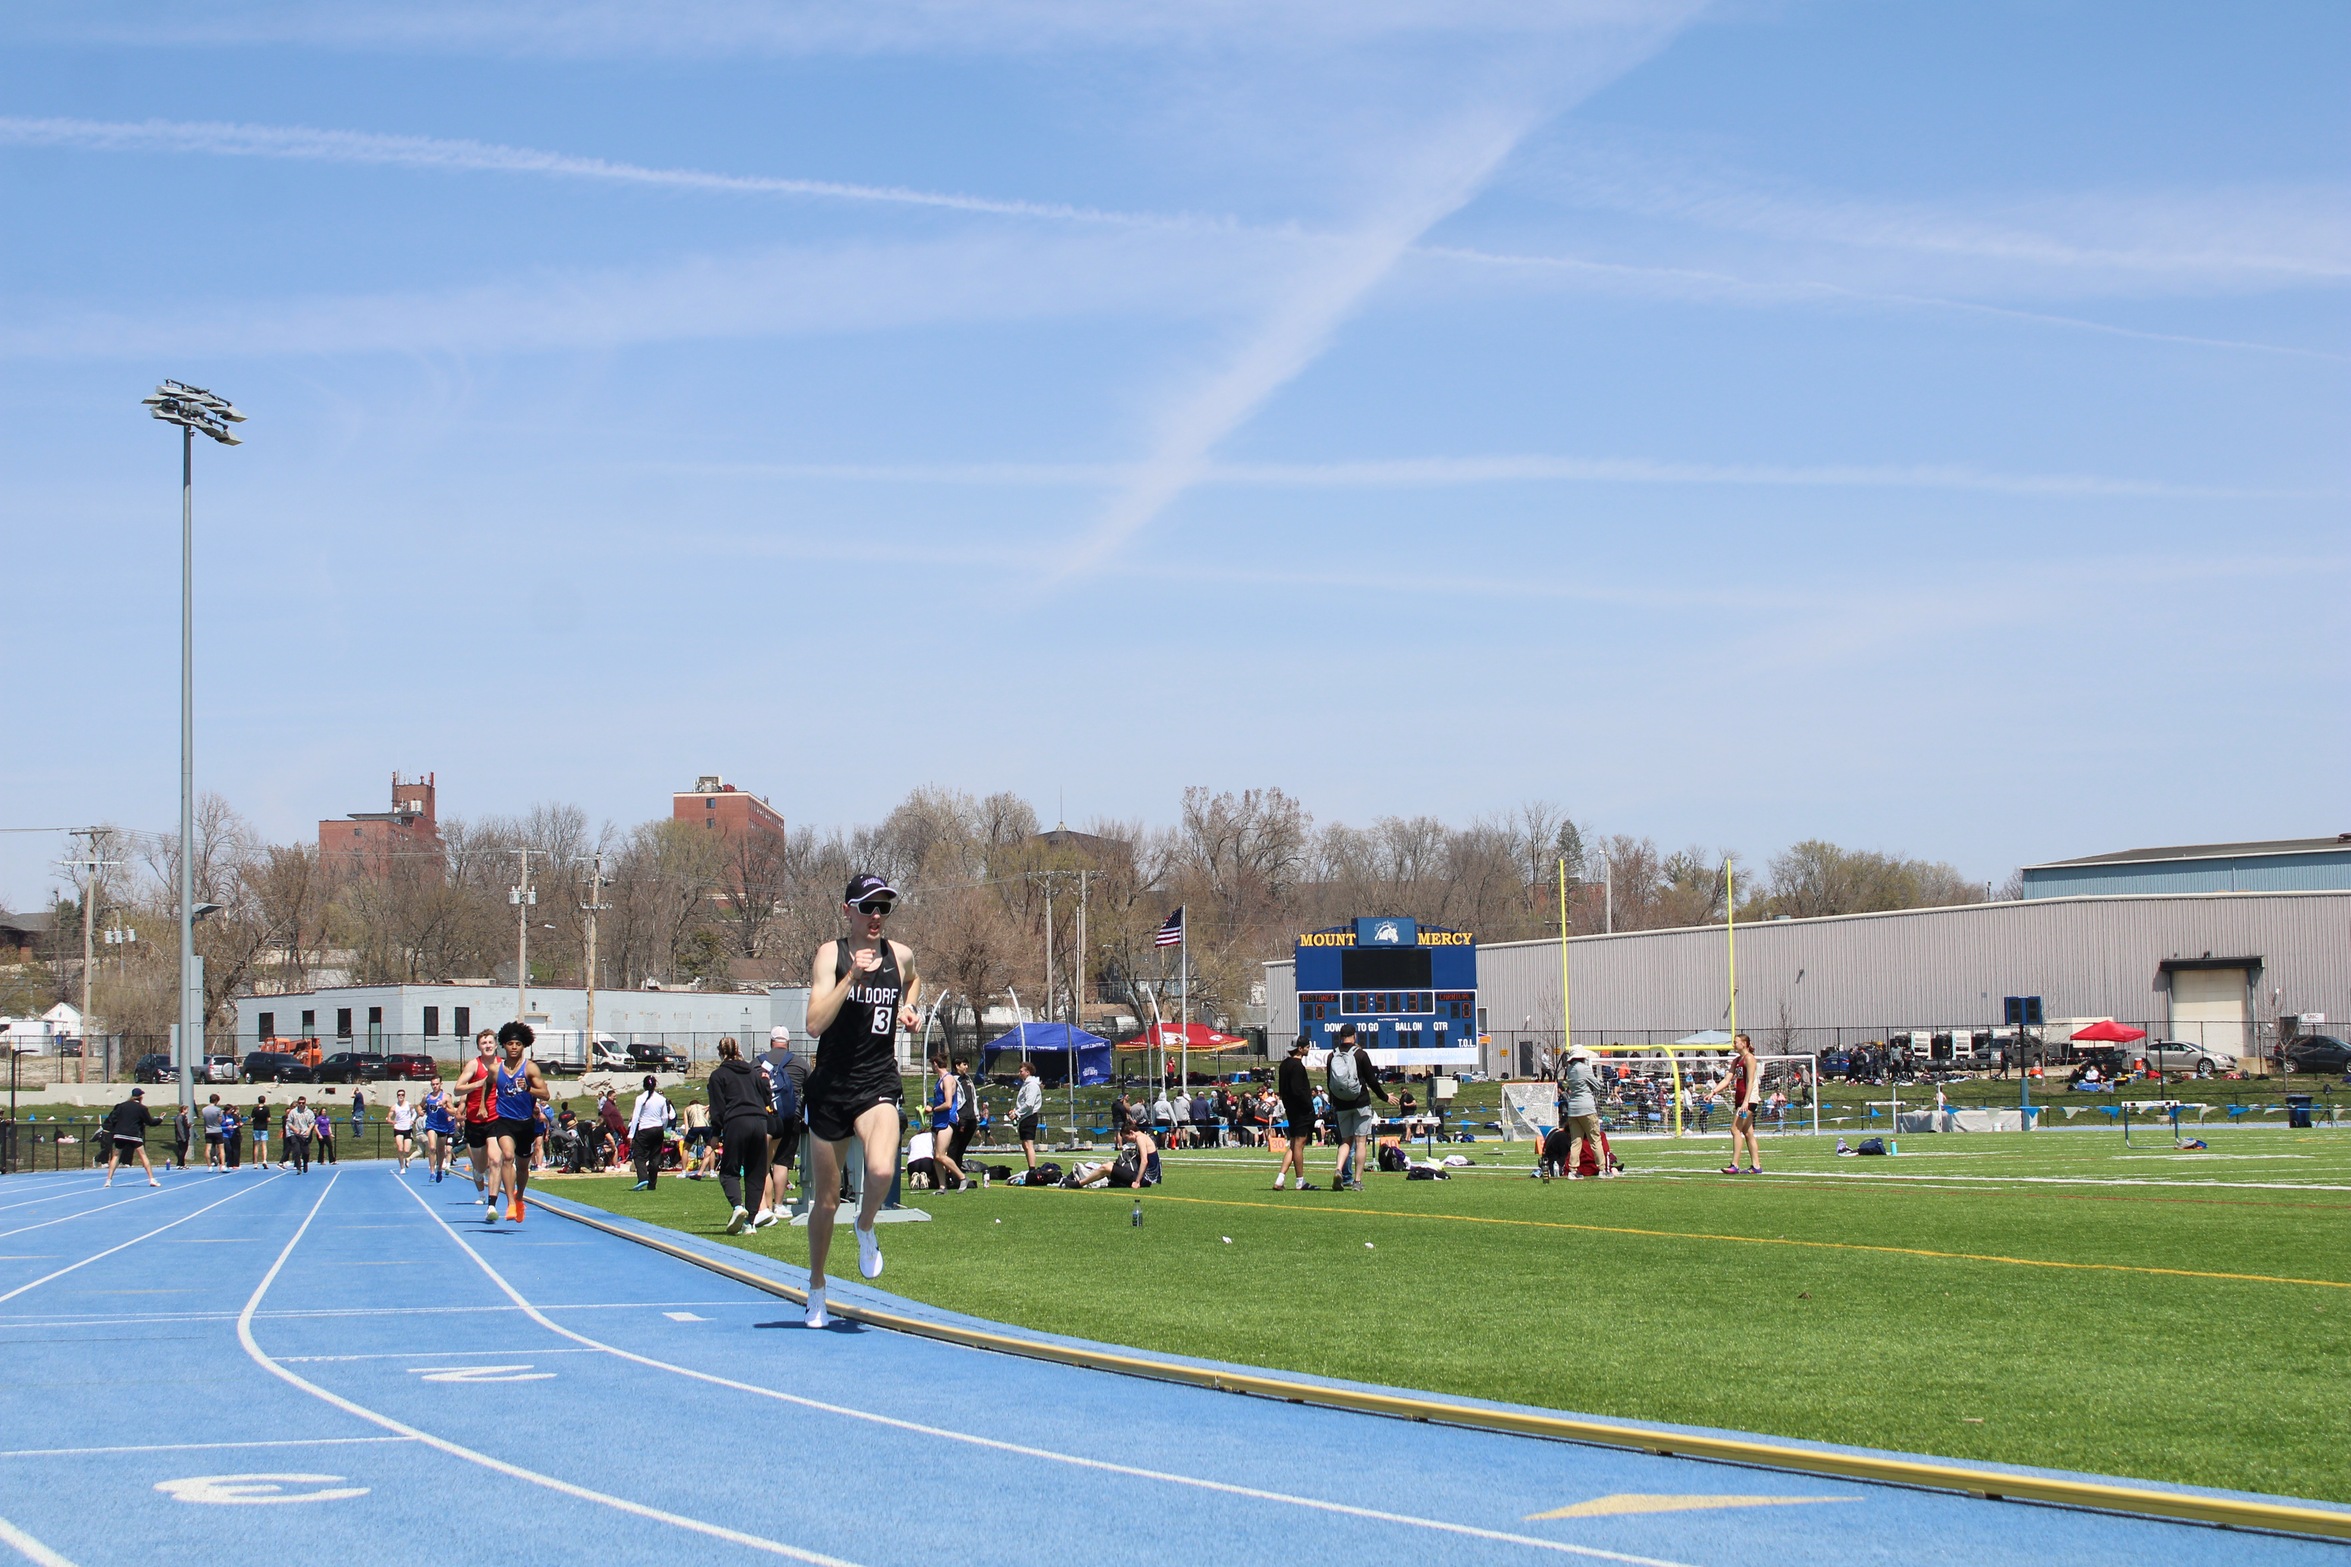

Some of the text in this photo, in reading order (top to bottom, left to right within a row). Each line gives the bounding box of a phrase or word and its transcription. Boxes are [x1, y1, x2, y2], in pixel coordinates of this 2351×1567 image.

[1300, 933, 1357, 947] MOUNT
[1418, 932, 1473, 945] MERCY
[847, 985, 899, 1005] ALDORF
[1302, 994, 1335, 1002] DISTANCE
[1316, 1004, 1325, 1020] 0
[1462, 1002, 1471, 1018] 0
[874, 1008, 889, 1033] 3
[1324, 1022, 1347, 1032] DOW
[1357, 1022, 1379, 1032] TO GO
[1395, 1022, 1423, 1032] BALL ON
[1433, 1021, 1449, 1032] QTR
[1457, 1038, 1476, 1048] T.O.L.
[1272, 1139, 1285, 1149] 30
